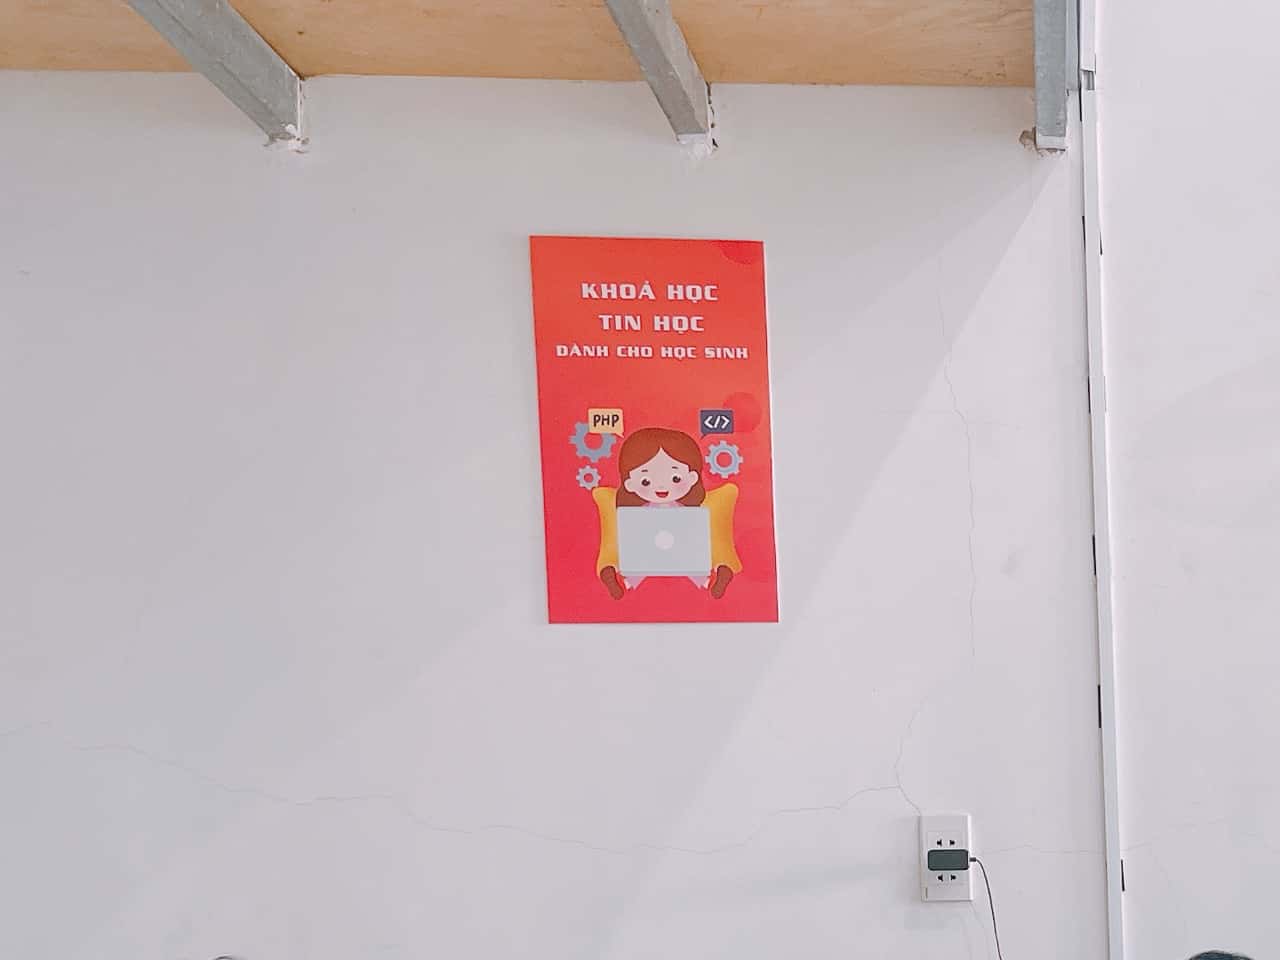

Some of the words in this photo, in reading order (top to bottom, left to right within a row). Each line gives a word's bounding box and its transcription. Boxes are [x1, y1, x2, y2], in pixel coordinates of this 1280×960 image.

[667, 283, 718, 303] HỌC
[598, 314, 641, 331] TIN
[654, 315, 705, 334] HỌC
[616, 345, 653, 358] CHO
[660, 345, 697, 361] HỌC
[703, 346, 749, 360] SINH
[593, 414, 620, 427] PHP
